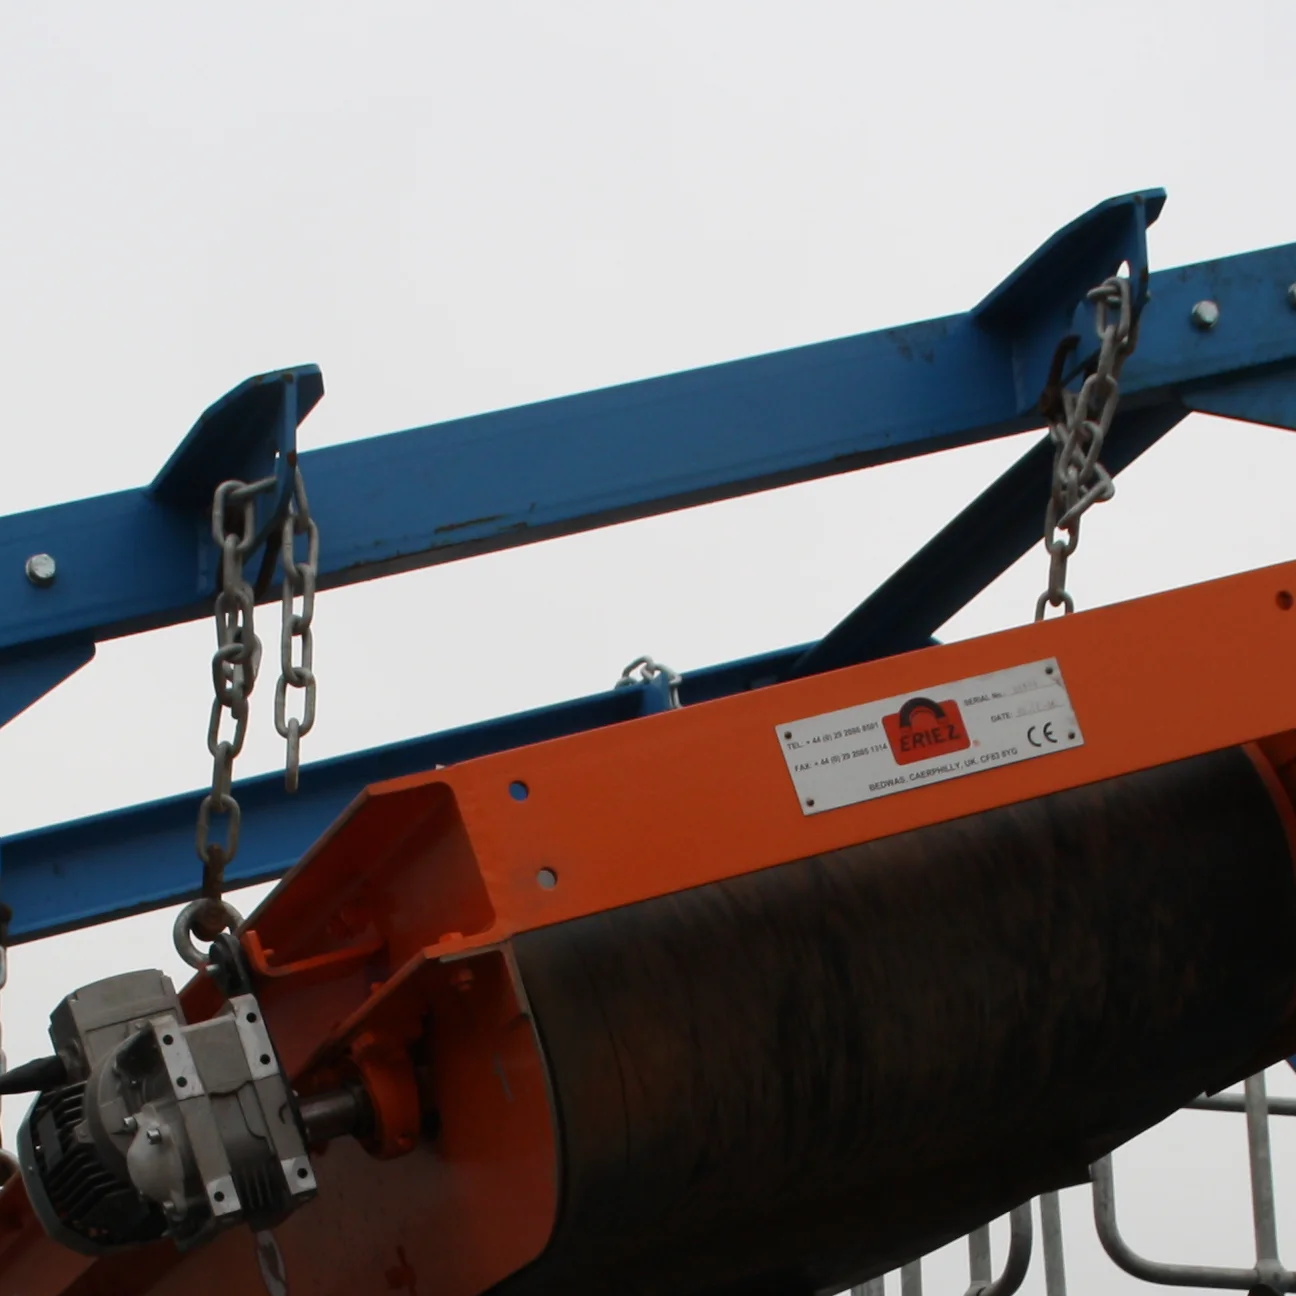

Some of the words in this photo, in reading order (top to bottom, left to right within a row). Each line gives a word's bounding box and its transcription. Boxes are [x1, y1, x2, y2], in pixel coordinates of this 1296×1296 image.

[964, 694, 990, 706] SERIAL
[990, 711, 1013, 723] DATE:
[900, 725, 961, 752] ERIEZ
[787, 740, 804, 750] TEL:
[820, 757, 829, 765] 44
